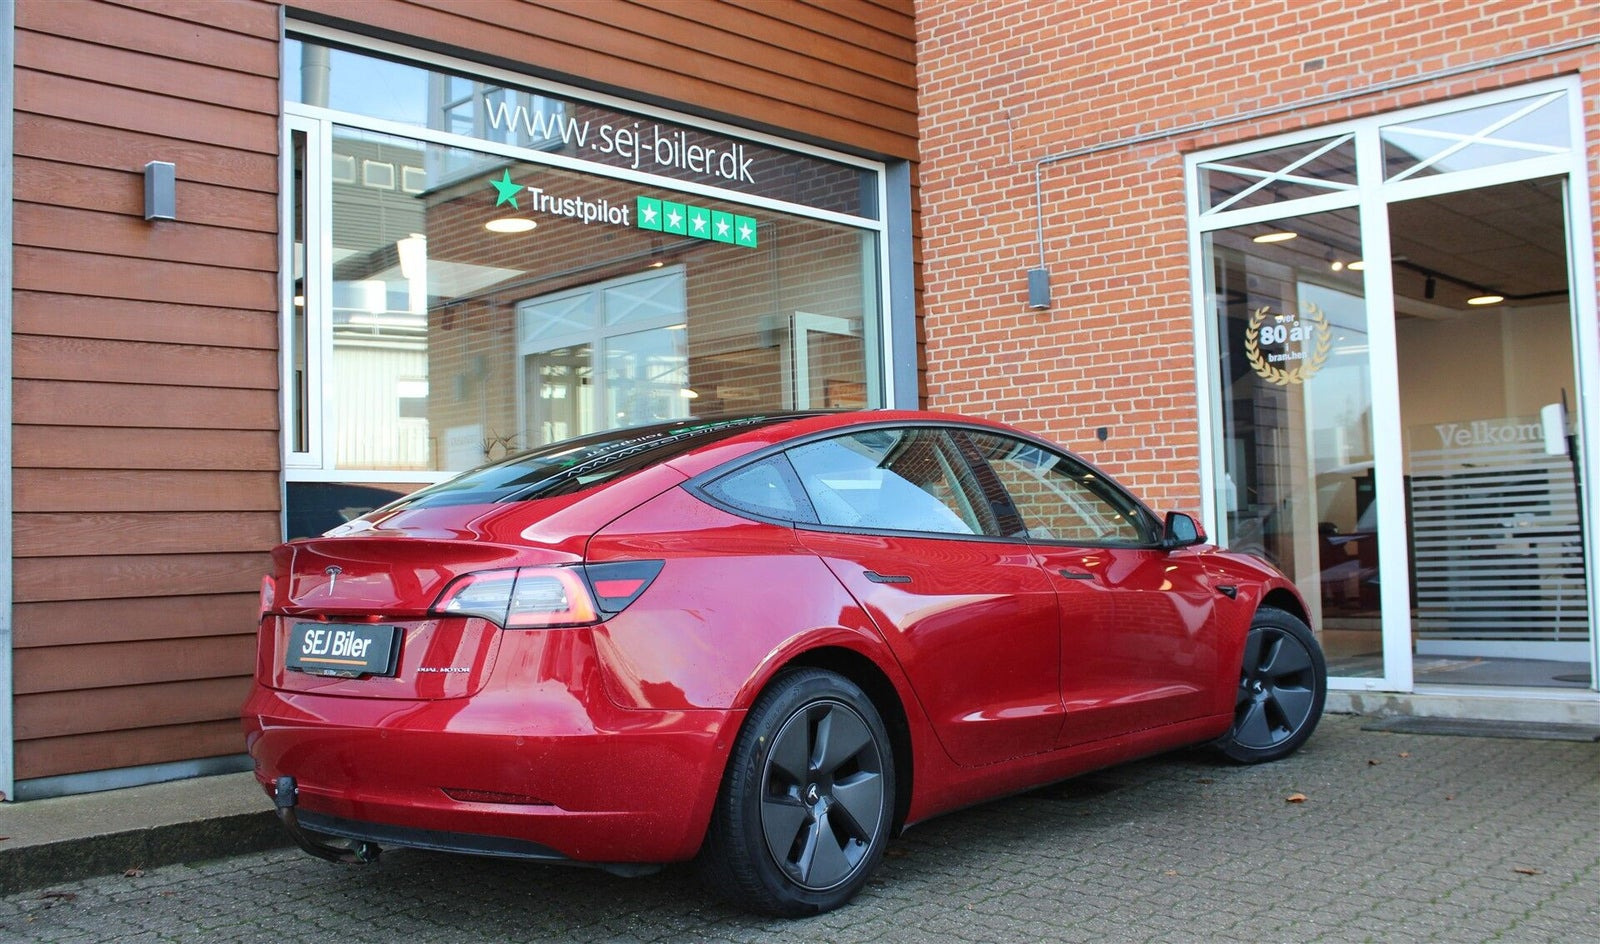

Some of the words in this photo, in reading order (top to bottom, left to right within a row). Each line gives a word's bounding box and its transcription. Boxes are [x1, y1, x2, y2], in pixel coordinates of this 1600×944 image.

[485, 97, 756, 185] www.sej-biler.dk
[527, 186, 630, 226] Trustpilot
[1260, 325, 1287, 345] 80
[1290, 321, 1313, 342] år
[302, 629, 331, 655] SEJ
[331, 630, 372, 658] Biler
